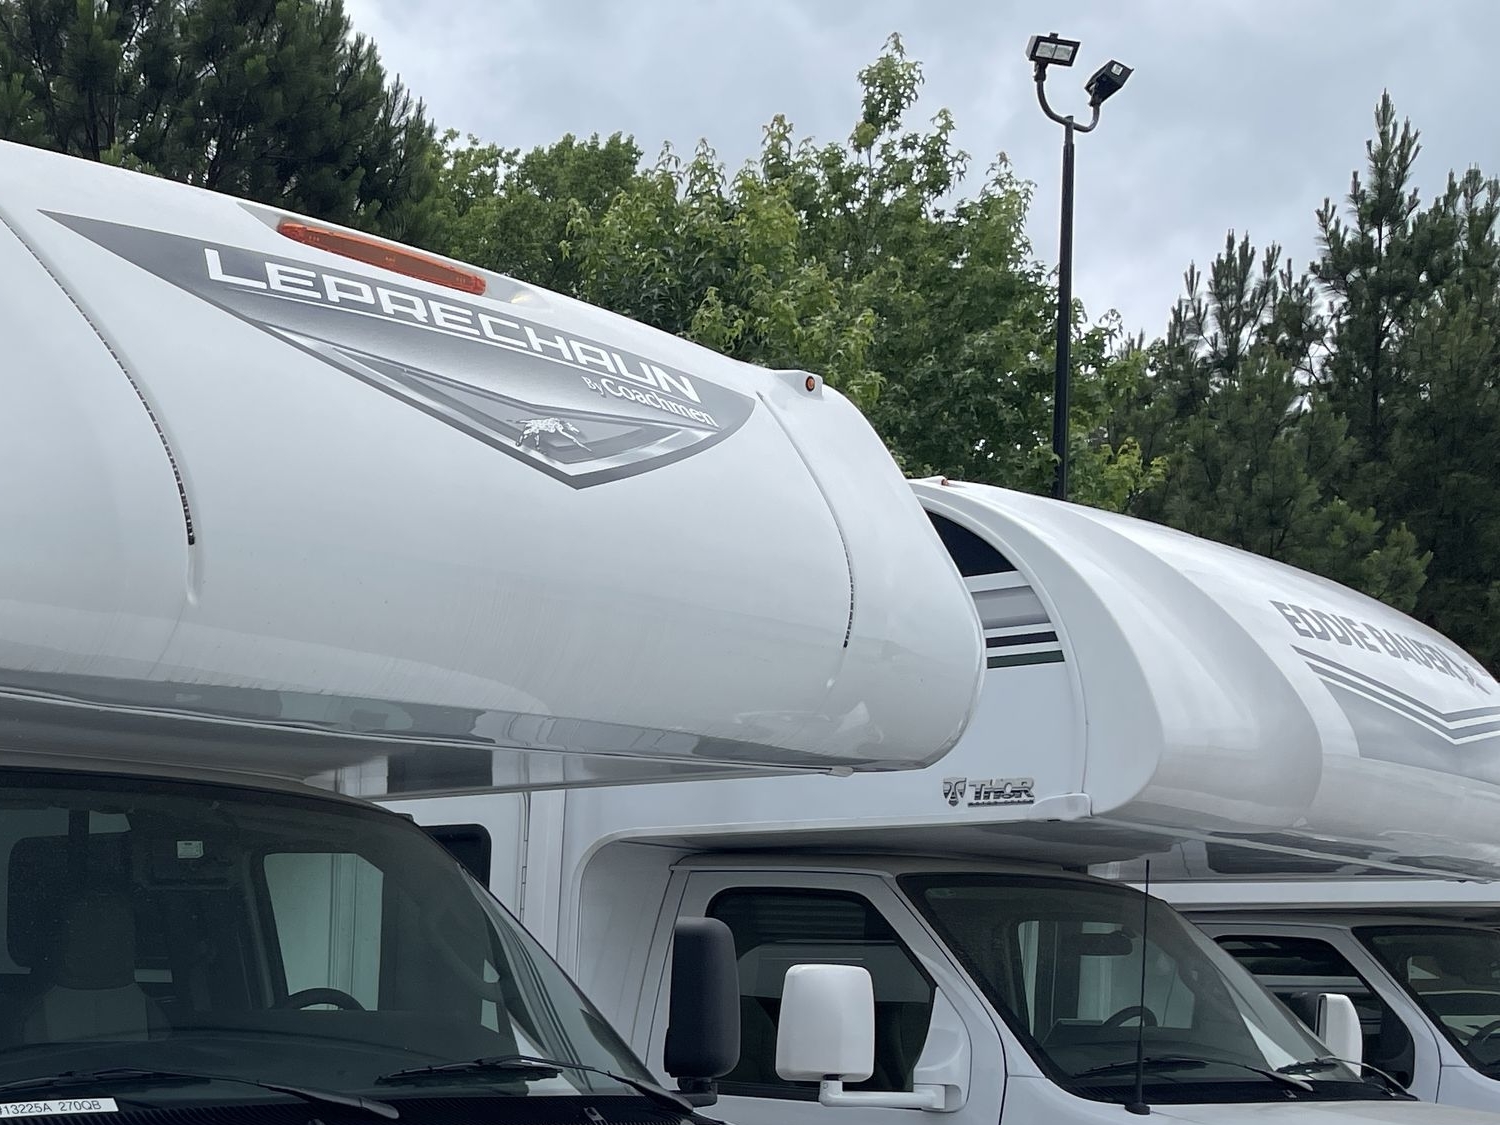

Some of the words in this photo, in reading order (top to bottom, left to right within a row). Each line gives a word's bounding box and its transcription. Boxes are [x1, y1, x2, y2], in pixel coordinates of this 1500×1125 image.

[203, 248, 702, 404] LEPRECHAUN
[601, 377, 720, 428] Coachmen
[1269, 600, 1382, 654] EDDIE
[1361, 622, 1464, 681] BAUER
[58, 1100, 102, 1113] 270QB
